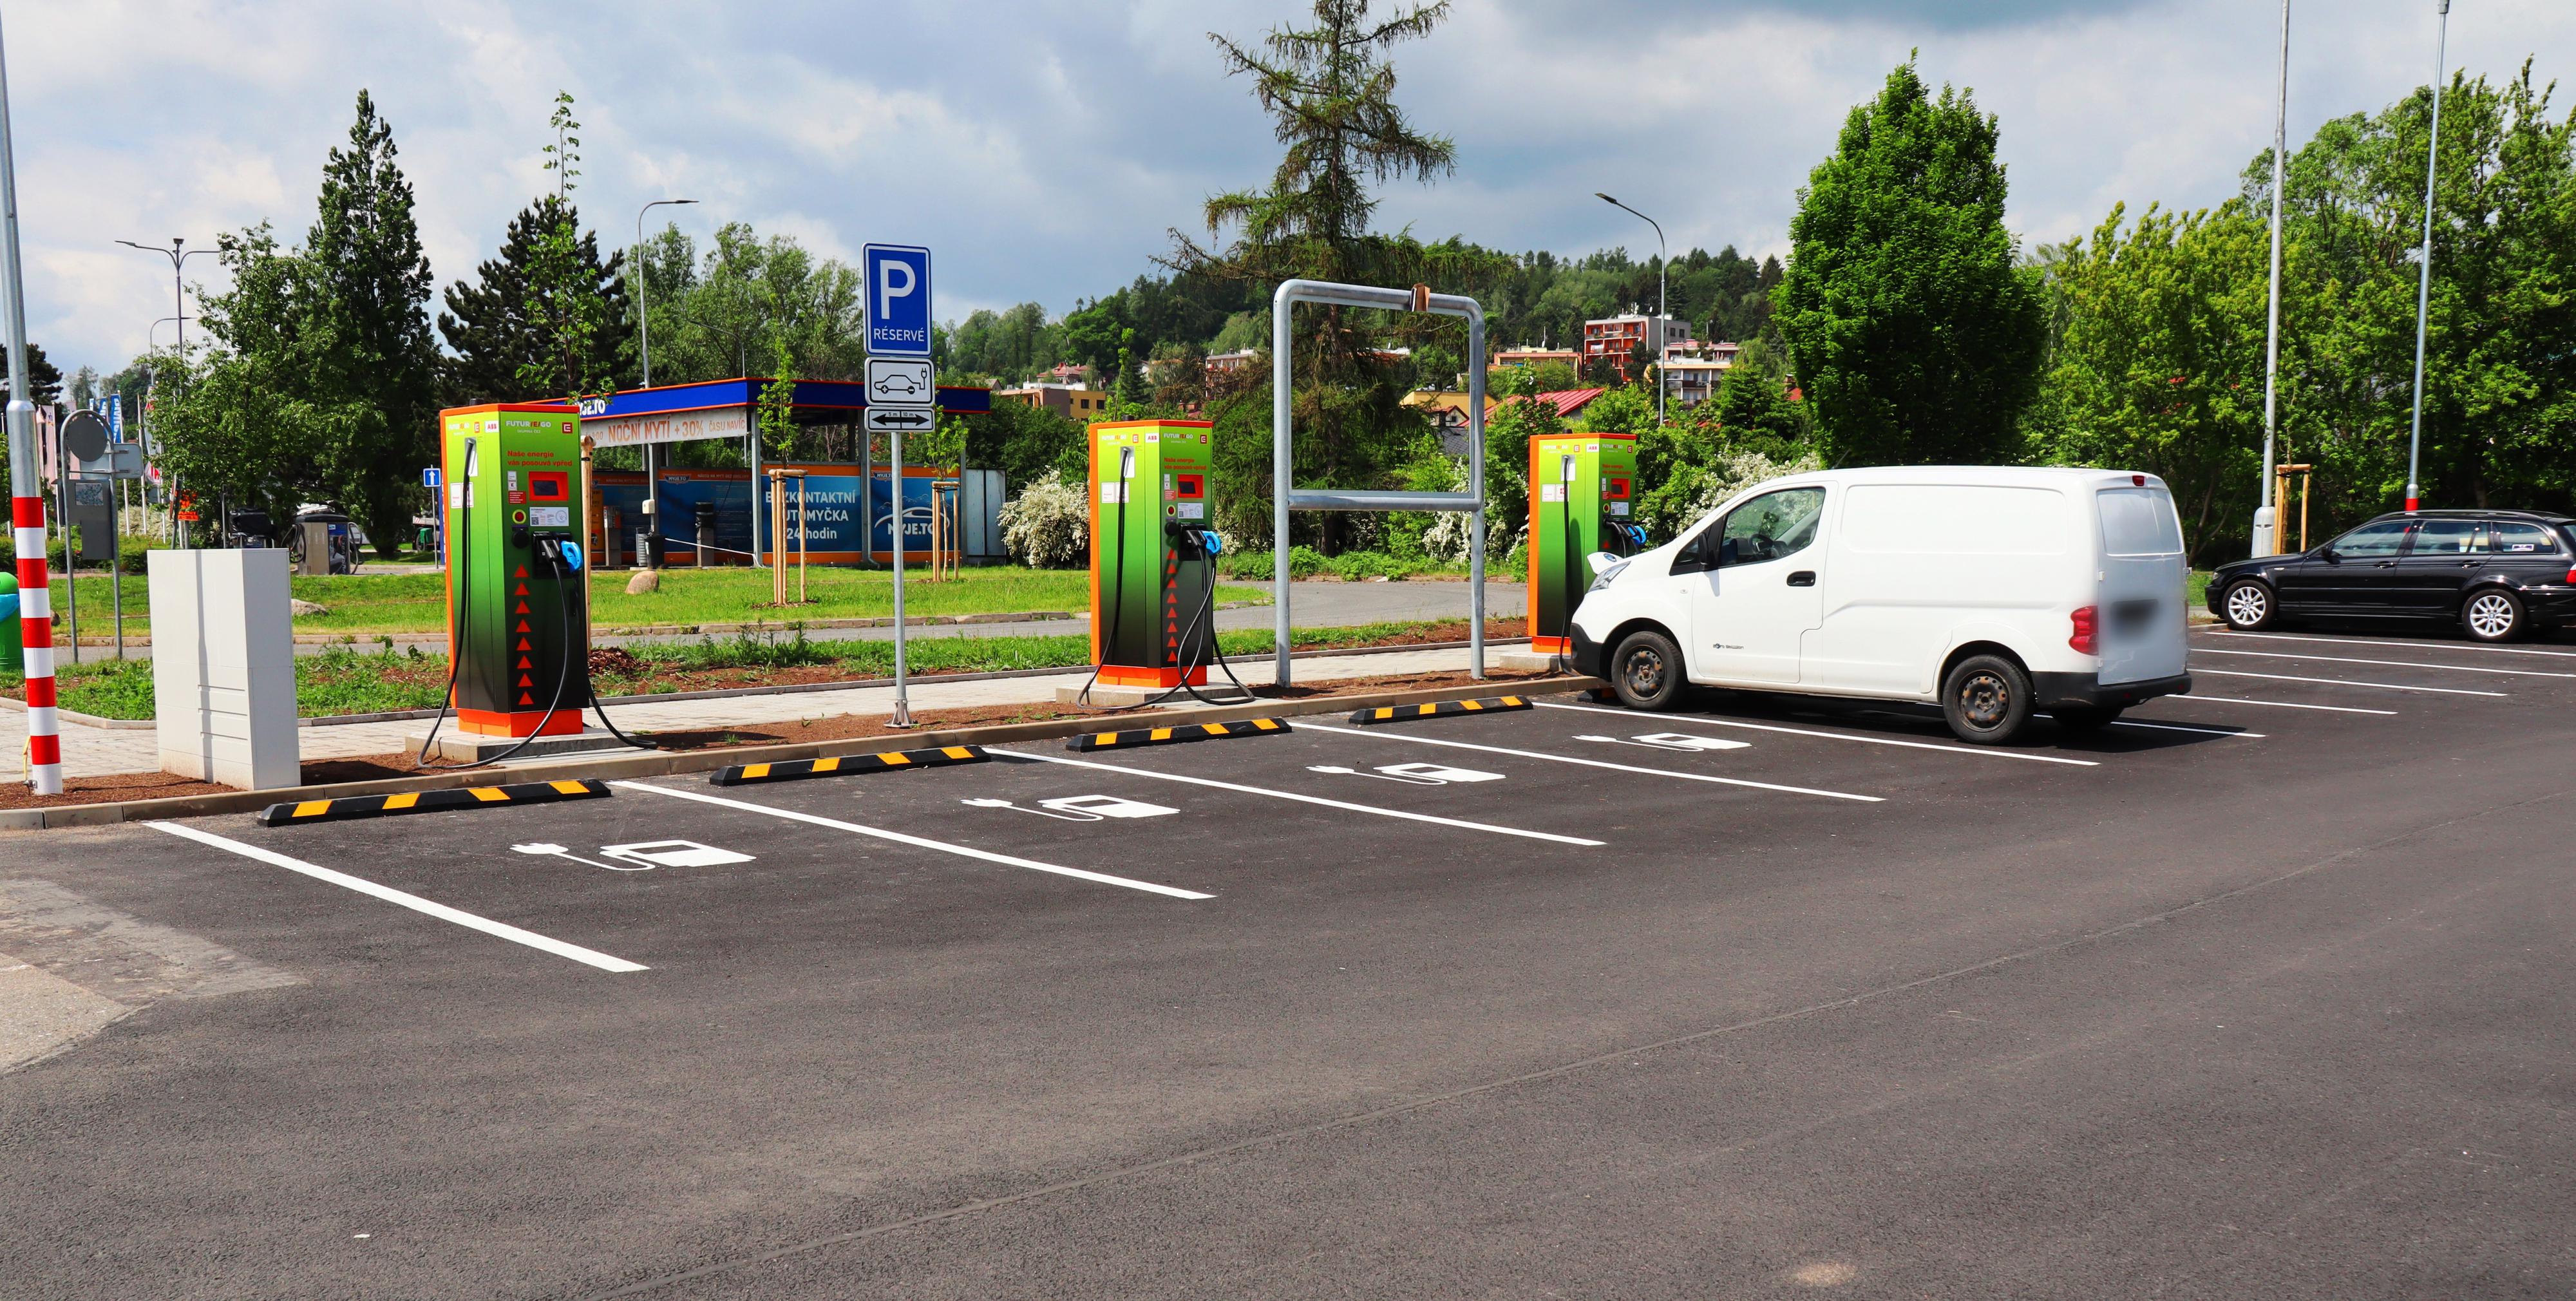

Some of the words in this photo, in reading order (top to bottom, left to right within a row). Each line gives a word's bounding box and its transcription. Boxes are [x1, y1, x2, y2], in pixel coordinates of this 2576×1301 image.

[880, 259, 916, 319] P
[874, 325, 925, 342] RÉSERVÉ
[607, 418, 641, 442] NOČNÍ
[644, 415, 670, 439] MYTÍ
[726, 417, 746, 430] NAVÍC
[805, 527, 837, 539] hodin
